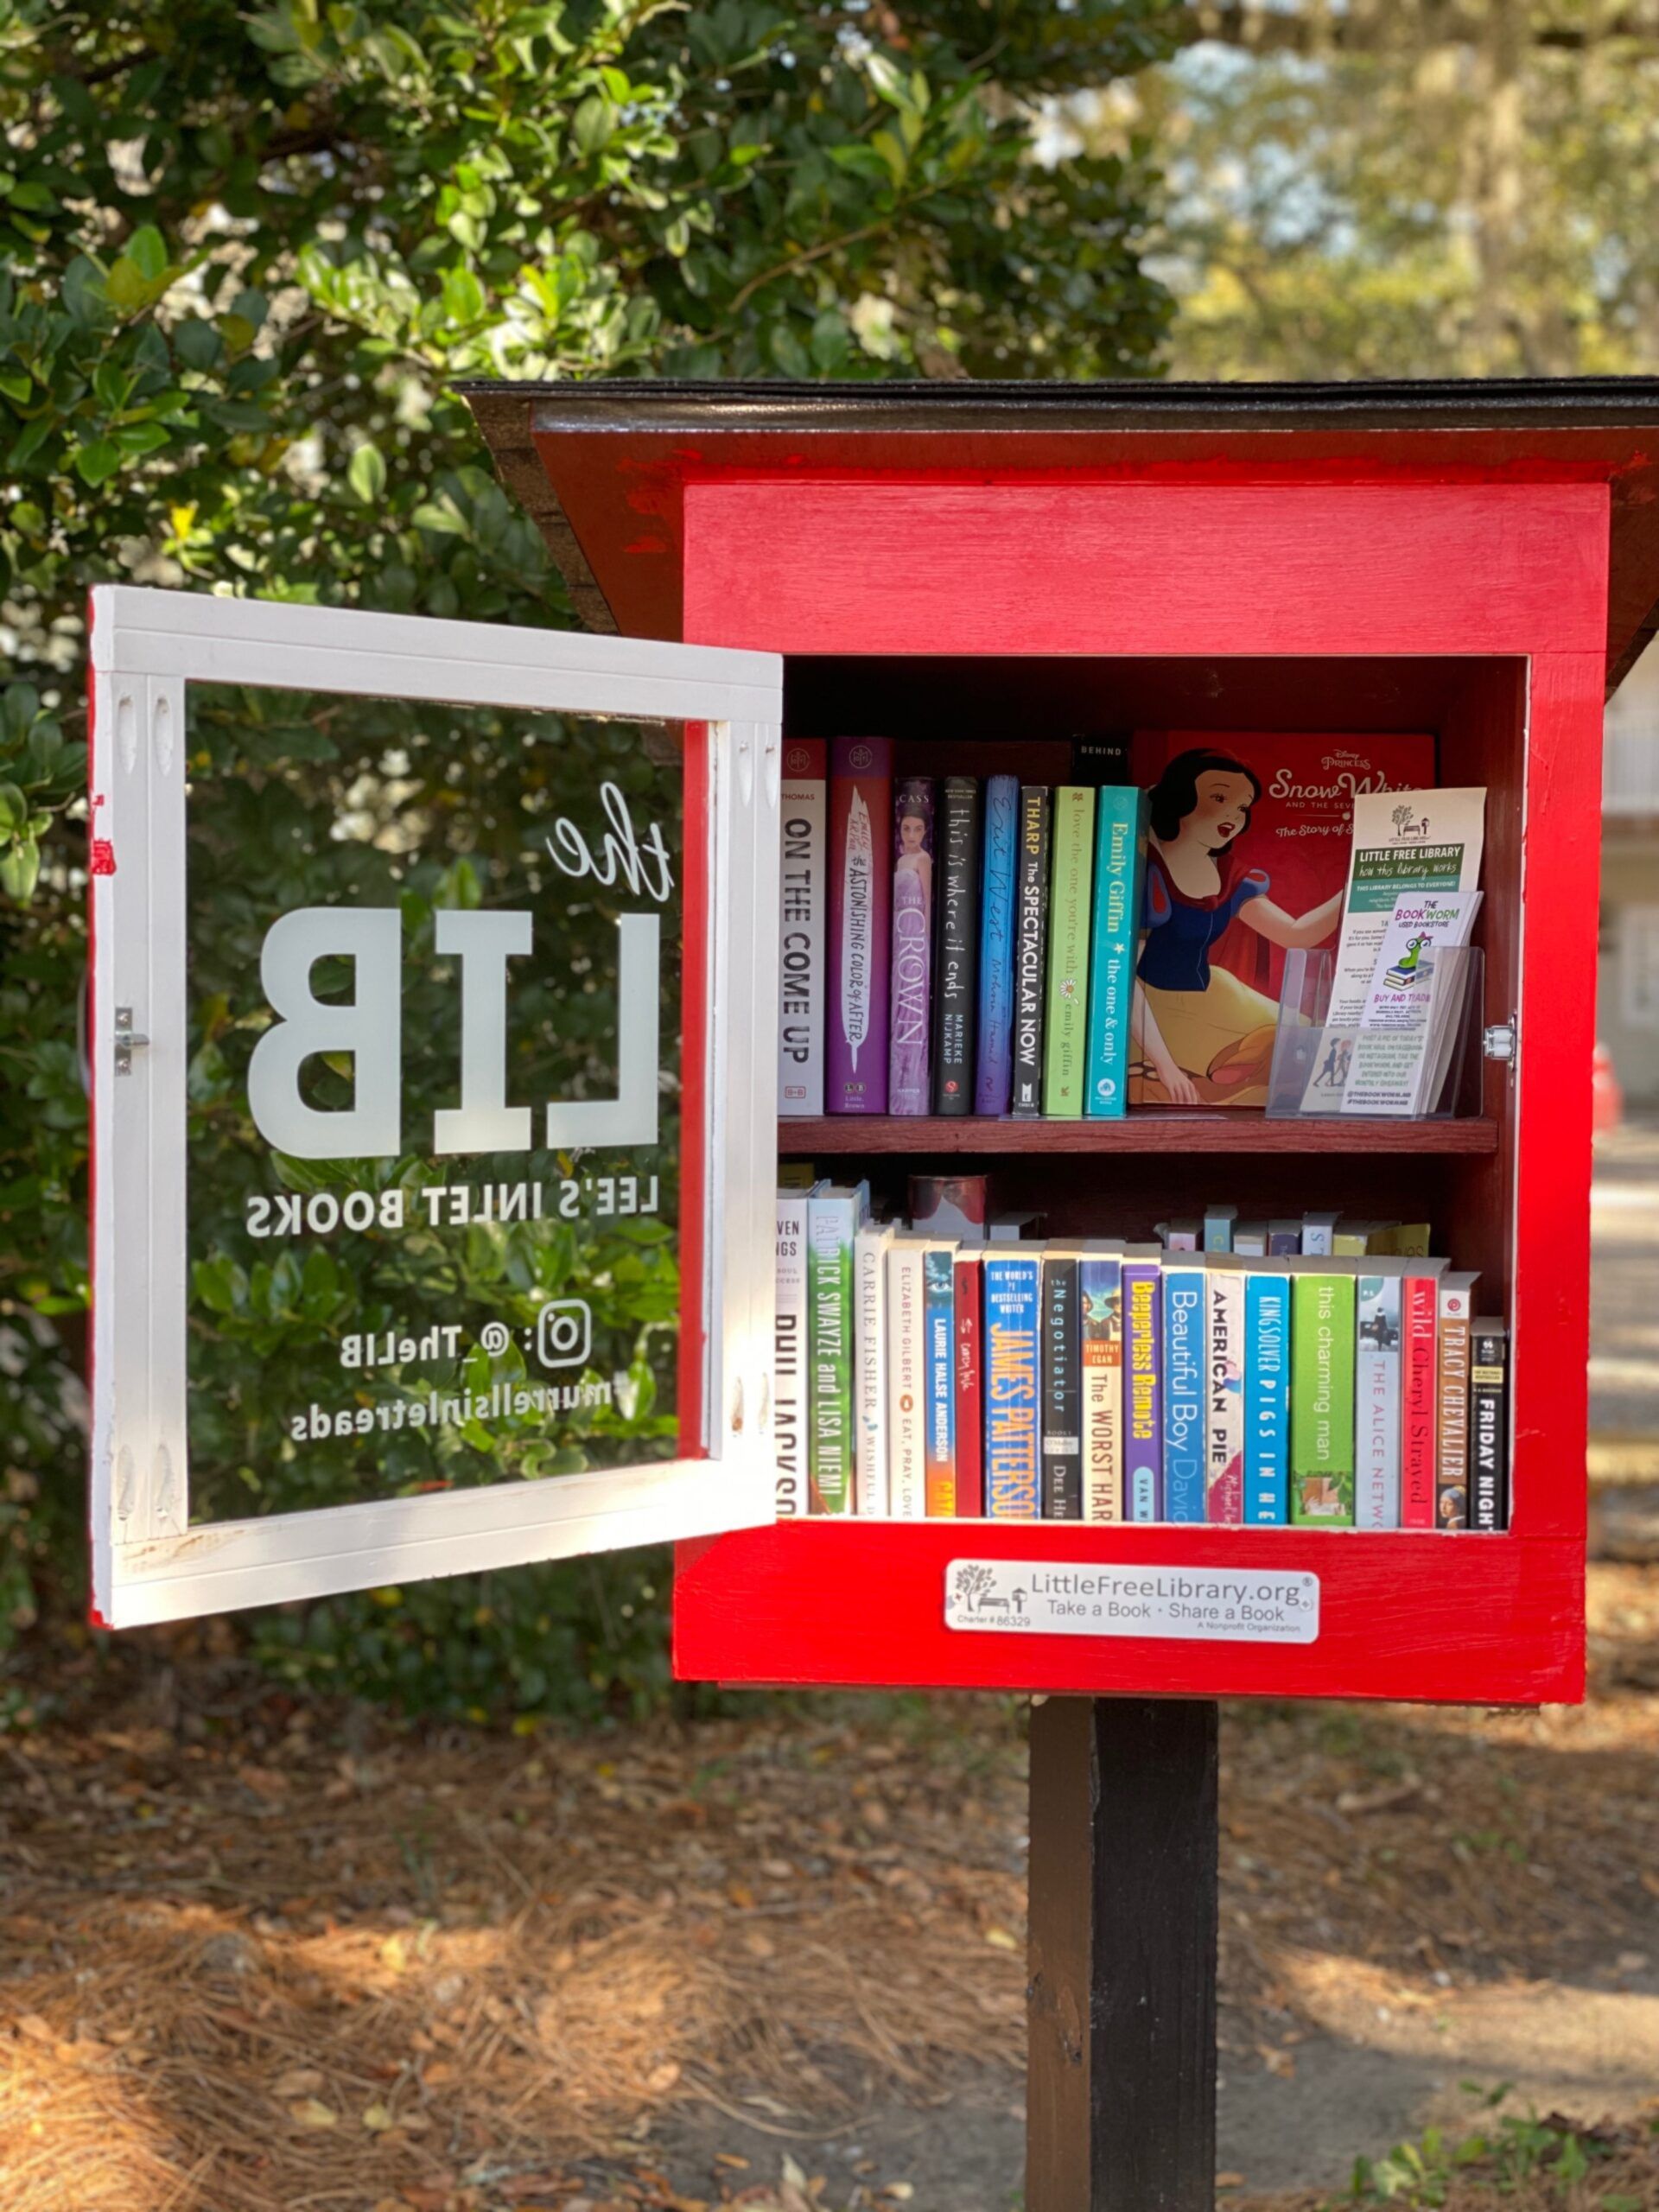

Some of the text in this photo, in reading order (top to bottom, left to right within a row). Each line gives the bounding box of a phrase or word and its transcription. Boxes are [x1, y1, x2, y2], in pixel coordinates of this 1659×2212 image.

[1081, 746, 1122, 756] BEHIND
[899, 794, 930, 804] CASS
[1268, 768, 1341, 799] Snow
[1026, 797, 1041, 855] THARP
[1275, 823, 1345, 838] The Story of
[988, 797, 1012, 942] Exit West
[1106, 822, 1128, 933] Emily Giffin
[1359, 846, 1461, 863] LITTLE FREE LIBRARY
[1359, 861, 1457, 880] how this library works
[849, 868, 868, 950] ASTONISHING
[902, 896, 923, 906] THE
[944, 809, 970, 999] this is where it ends
[1064, 809, 1085, 974] love the one you're with
[1395, 908, 1460, 921] BOOKWORM
[783, 818, 812, 1064] ON THE COME UP
[1020, 861, 1040, 1066] The SPECTACULAR NOW
[849, 952, 864, 990] COLOR
[895, 907, 926, 1046] CROWN
[848, 1001, 863, 1042] AFTER
[1100, 959, 1122, 1065] the one & only
[1374, 994, 1389, 1003] BUY
[1390, 994, 1407, 1002] AND
[943, 1014, 953, 1065] NIJKAMP
[953, 1014, 964, 1065] MARIEKE
[1060, 1003, 1074, 1077] emily giffin
[990, 1293, 1033, 1303] BESTSELLING
[991, 1271, 1033, 1280] THE WORLD'S
[862, 1252, 877, 1408] CARRIE FISHER
[901, 1266, 912, 1389] ELIZABETH GILBERT
[999, 1304, 1025, 1314] WRITER
[1257, 1296, 1281, 1373] KINGSOLVER
[816, 1216, 842, 1495] PATRICK SWAYZE and LISA NIEMI
[989, 1322, 1035, 1401] JAMES
[1050, 1289, 1067, 1412] Negotiator
[1085, 1344, 1119, 1354] TIMOTHY
[1092, 1355, 1113, 1364] EGAN
[1128, 1281, 1156, 1440] Beeperless Remote
[1172, 1291, 1198, 1395] Beautiful
[1443, 1326, 1465, 1378] TRACY
[934, 1319, 949, 1462] LAURIE HALSE ANDERSON
[1091, 1374, 1107, 1402] The
[1212, 1289, 1227, 1464] AMERICAN PIE
[1313, 1285, 1335, 1461] this charming man
[1373, 1361, 1386, 1396] THE
[1411, 1347, 1430, 1416] Cheryl
[1164, 1403, 1198, 1452] Boy
[1258, 1379, 1276, 1438] PIGS
[1372, 1404, 1385, 1459] ALICE
[1442, 1386, 1465, 1477] CHEVALIER
[1478, 1399, 1495, 1470] FRIDAY
[1091, 1409, 1113, 1476] WORST
[1258, 1452, 1276, 1478] IN
[1410, 1423, 1430, 1504] Strayed
[902, 1488, 912, 1517] LOVE
[1053, 1465, 1066, 1494] DEE
[1139, 1478, 1148, 1503] VAN
[1478, 1476, 1495, 1530] NIGH
[1031, 1573, 1300, 1607] LittleFreeLibrary.org
[1047, 1599, 1285, 1622] Take a Book Share a Book
[957, 1614, 988, 1624] Charter
[996, 1615, 1031, 1627] 86329
[1206, 1622, 1245, 1632] Nonprofit
[1247, 1623, 1300, 1633] Organization
